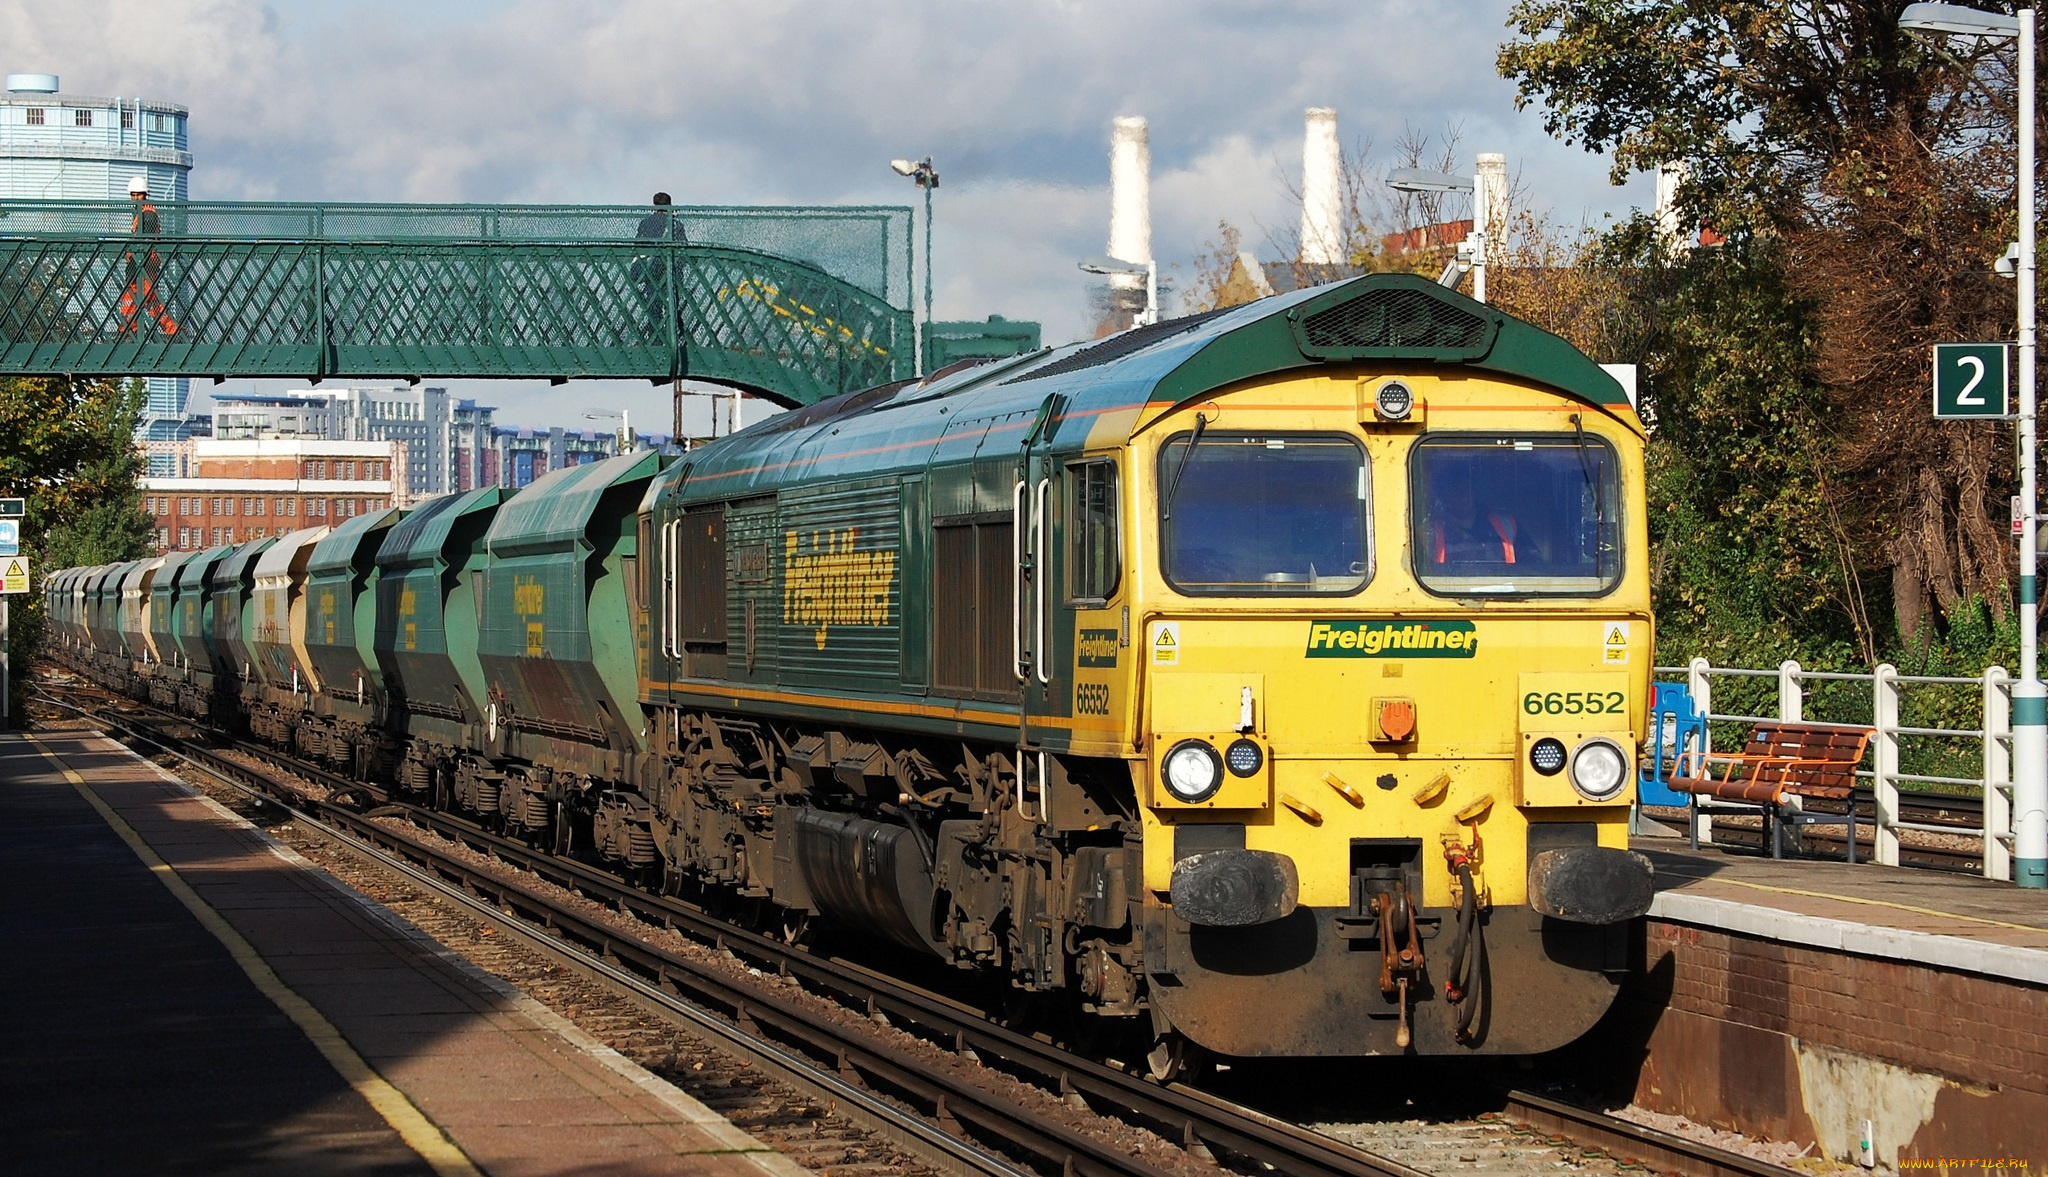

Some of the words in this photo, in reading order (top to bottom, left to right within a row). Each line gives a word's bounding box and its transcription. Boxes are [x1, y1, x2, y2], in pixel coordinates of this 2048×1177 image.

[1957, 356, 1985, 405] 2
[784, 527, 894, 650] Freightliner
[1079, 633, 1117, 662] Freightliner
[1309, 624, 1477, 655] Freightliner
[1077, 683, 1109, 715] 66552
[1524, 692, 1624, 714] 66552
